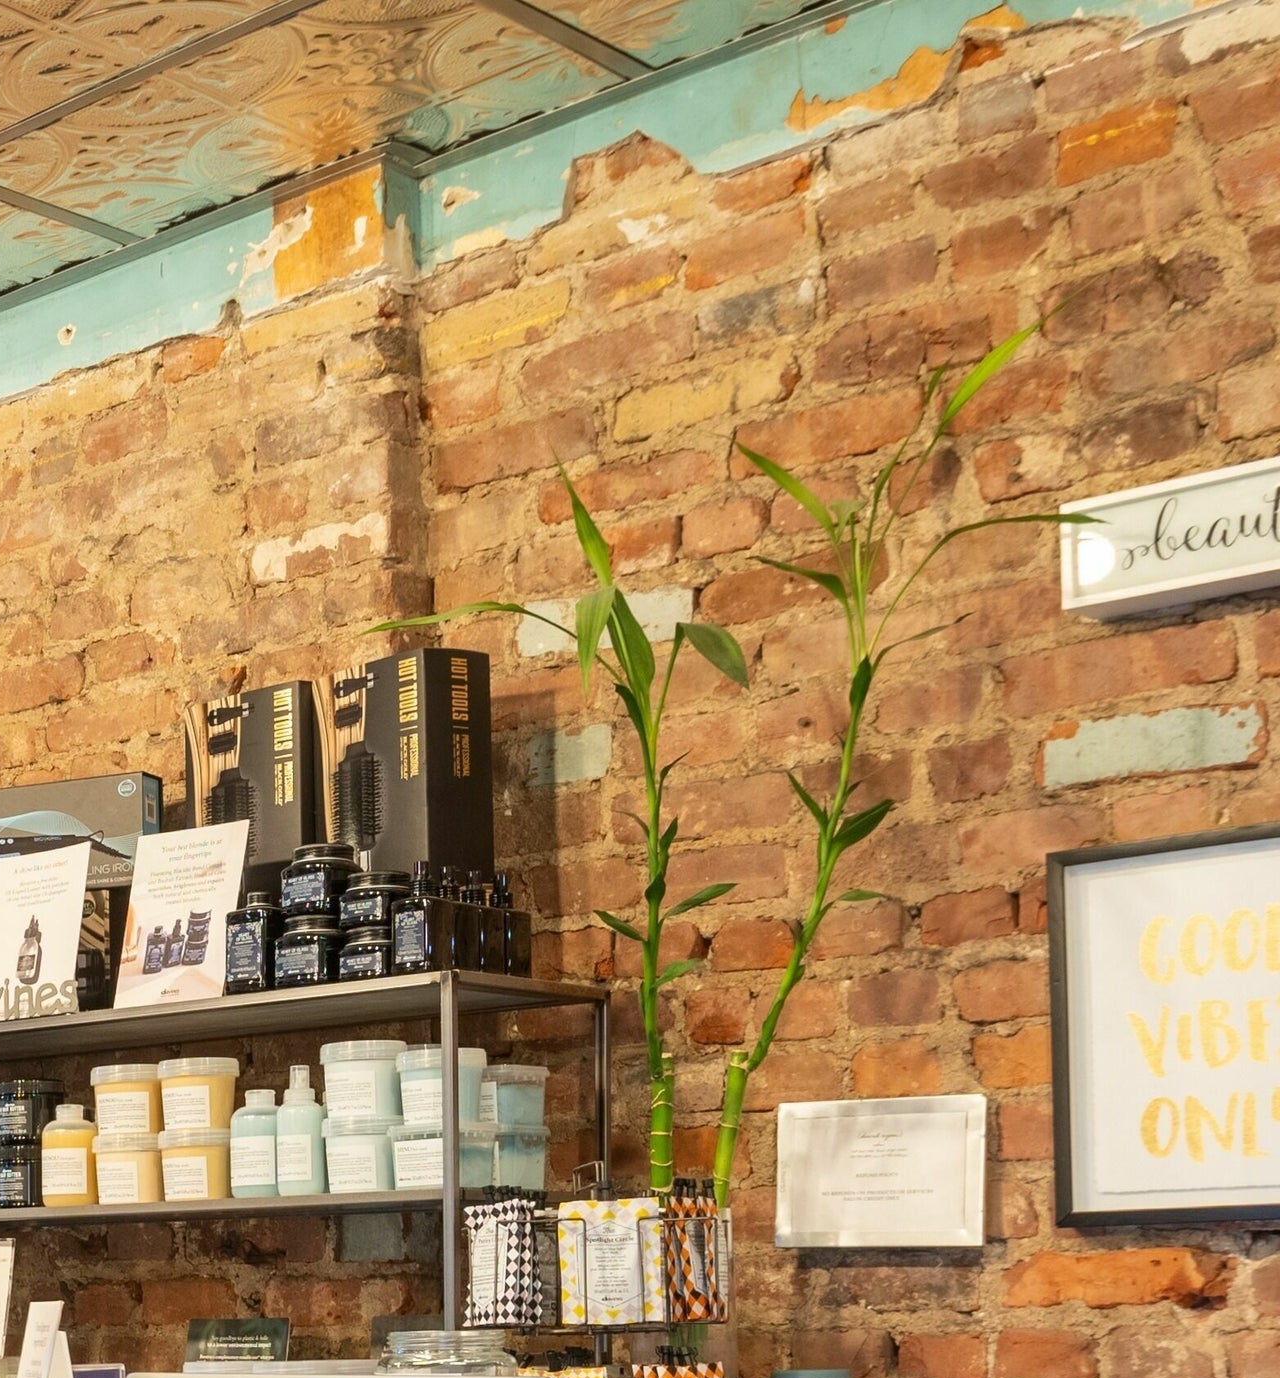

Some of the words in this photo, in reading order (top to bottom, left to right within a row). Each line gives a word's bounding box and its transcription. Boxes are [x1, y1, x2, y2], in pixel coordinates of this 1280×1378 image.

[1122, 486, 1280, 570] beaut
[398, 657, 417, 683] HOT
[451, 657, 468, 683] HOT
[272, 688, 293, 713] HOT
[398, 682, 418, 724] TOOLS
[451, 683, 469, 722] TOOLS
[273, 714, 294, 752] TOOLS
[1124, 998, 1280, 1078] VIBE
